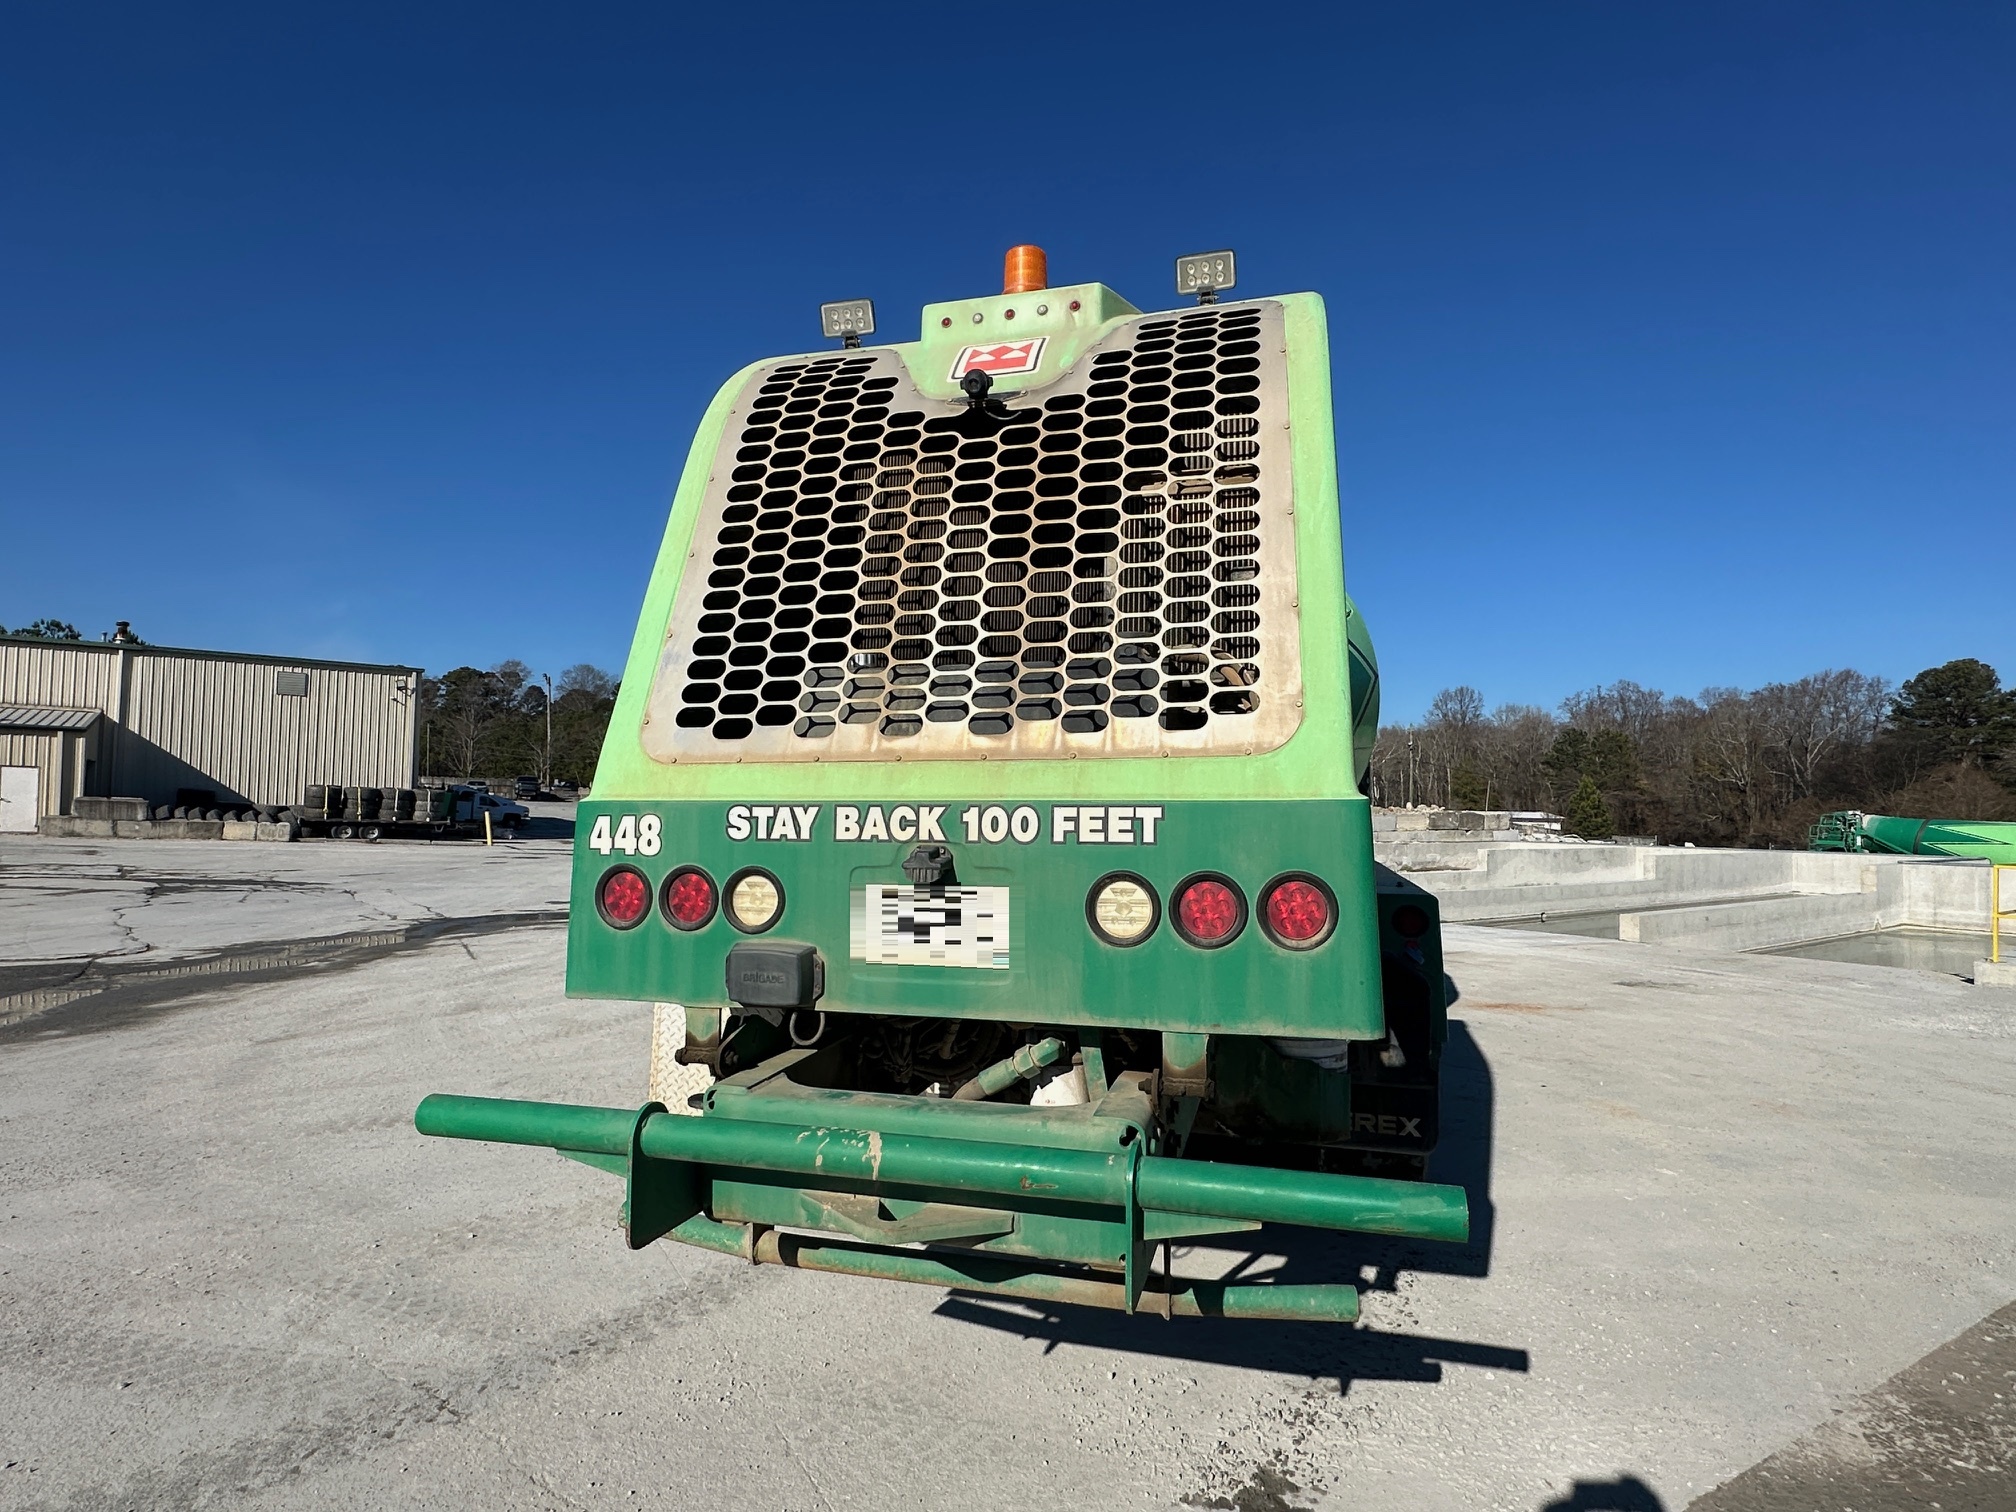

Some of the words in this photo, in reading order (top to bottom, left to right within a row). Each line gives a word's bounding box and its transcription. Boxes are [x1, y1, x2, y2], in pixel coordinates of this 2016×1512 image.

[589, 813, 663, 857] 448
[726, 804, 820, 842] STAY
[834, 805, 947, 842] BACK
[961, 804, 1040, 844] 100
[1051, 804, 1164, 845] FEET
[1350, 1112, 1422, 1138] REX
